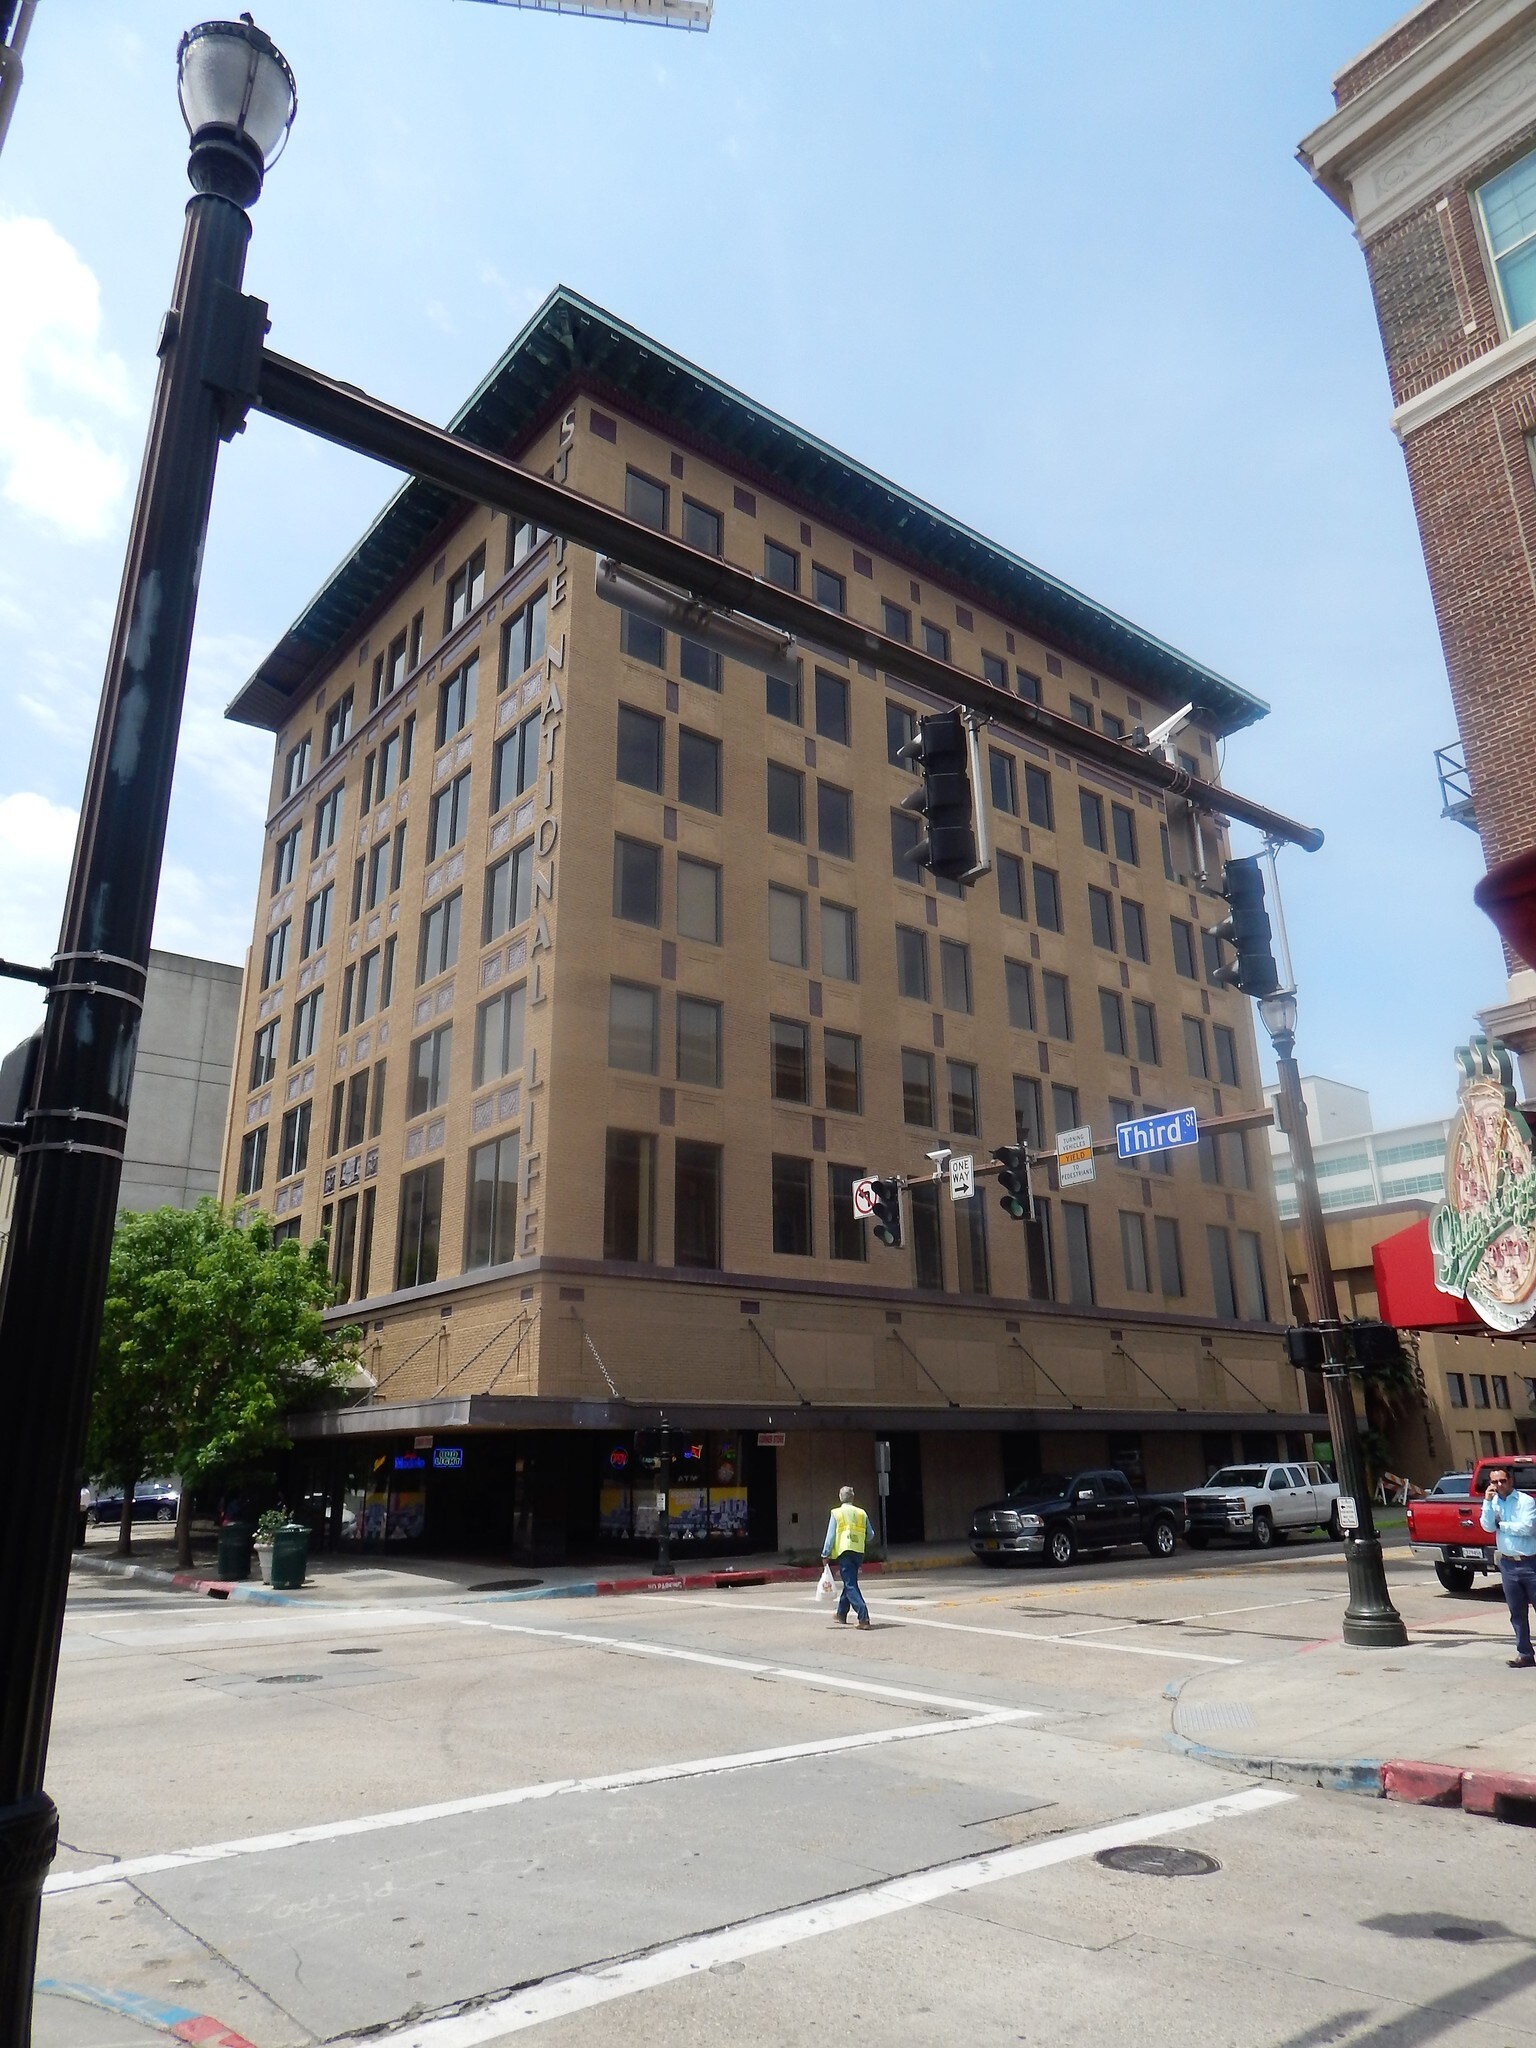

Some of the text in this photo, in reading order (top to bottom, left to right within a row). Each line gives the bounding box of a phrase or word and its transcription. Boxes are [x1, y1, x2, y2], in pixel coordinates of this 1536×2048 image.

[519, 408, 577, 1255] STTE NATIONAL LIFE
[1063, 1133, 1084, 1144] TURNING
[1118, 1112, 1195, 1153] Third St
[1062, 1141, 1086, 1151] VEHICLES
[1065, 1152, 1086, 1162] YIELD
[952, 1159, 970, 1173] ONE
[952, 1170, 970, 1184] WAY
[1061, 1168, 1093, 1180] PEDESTRIANS
